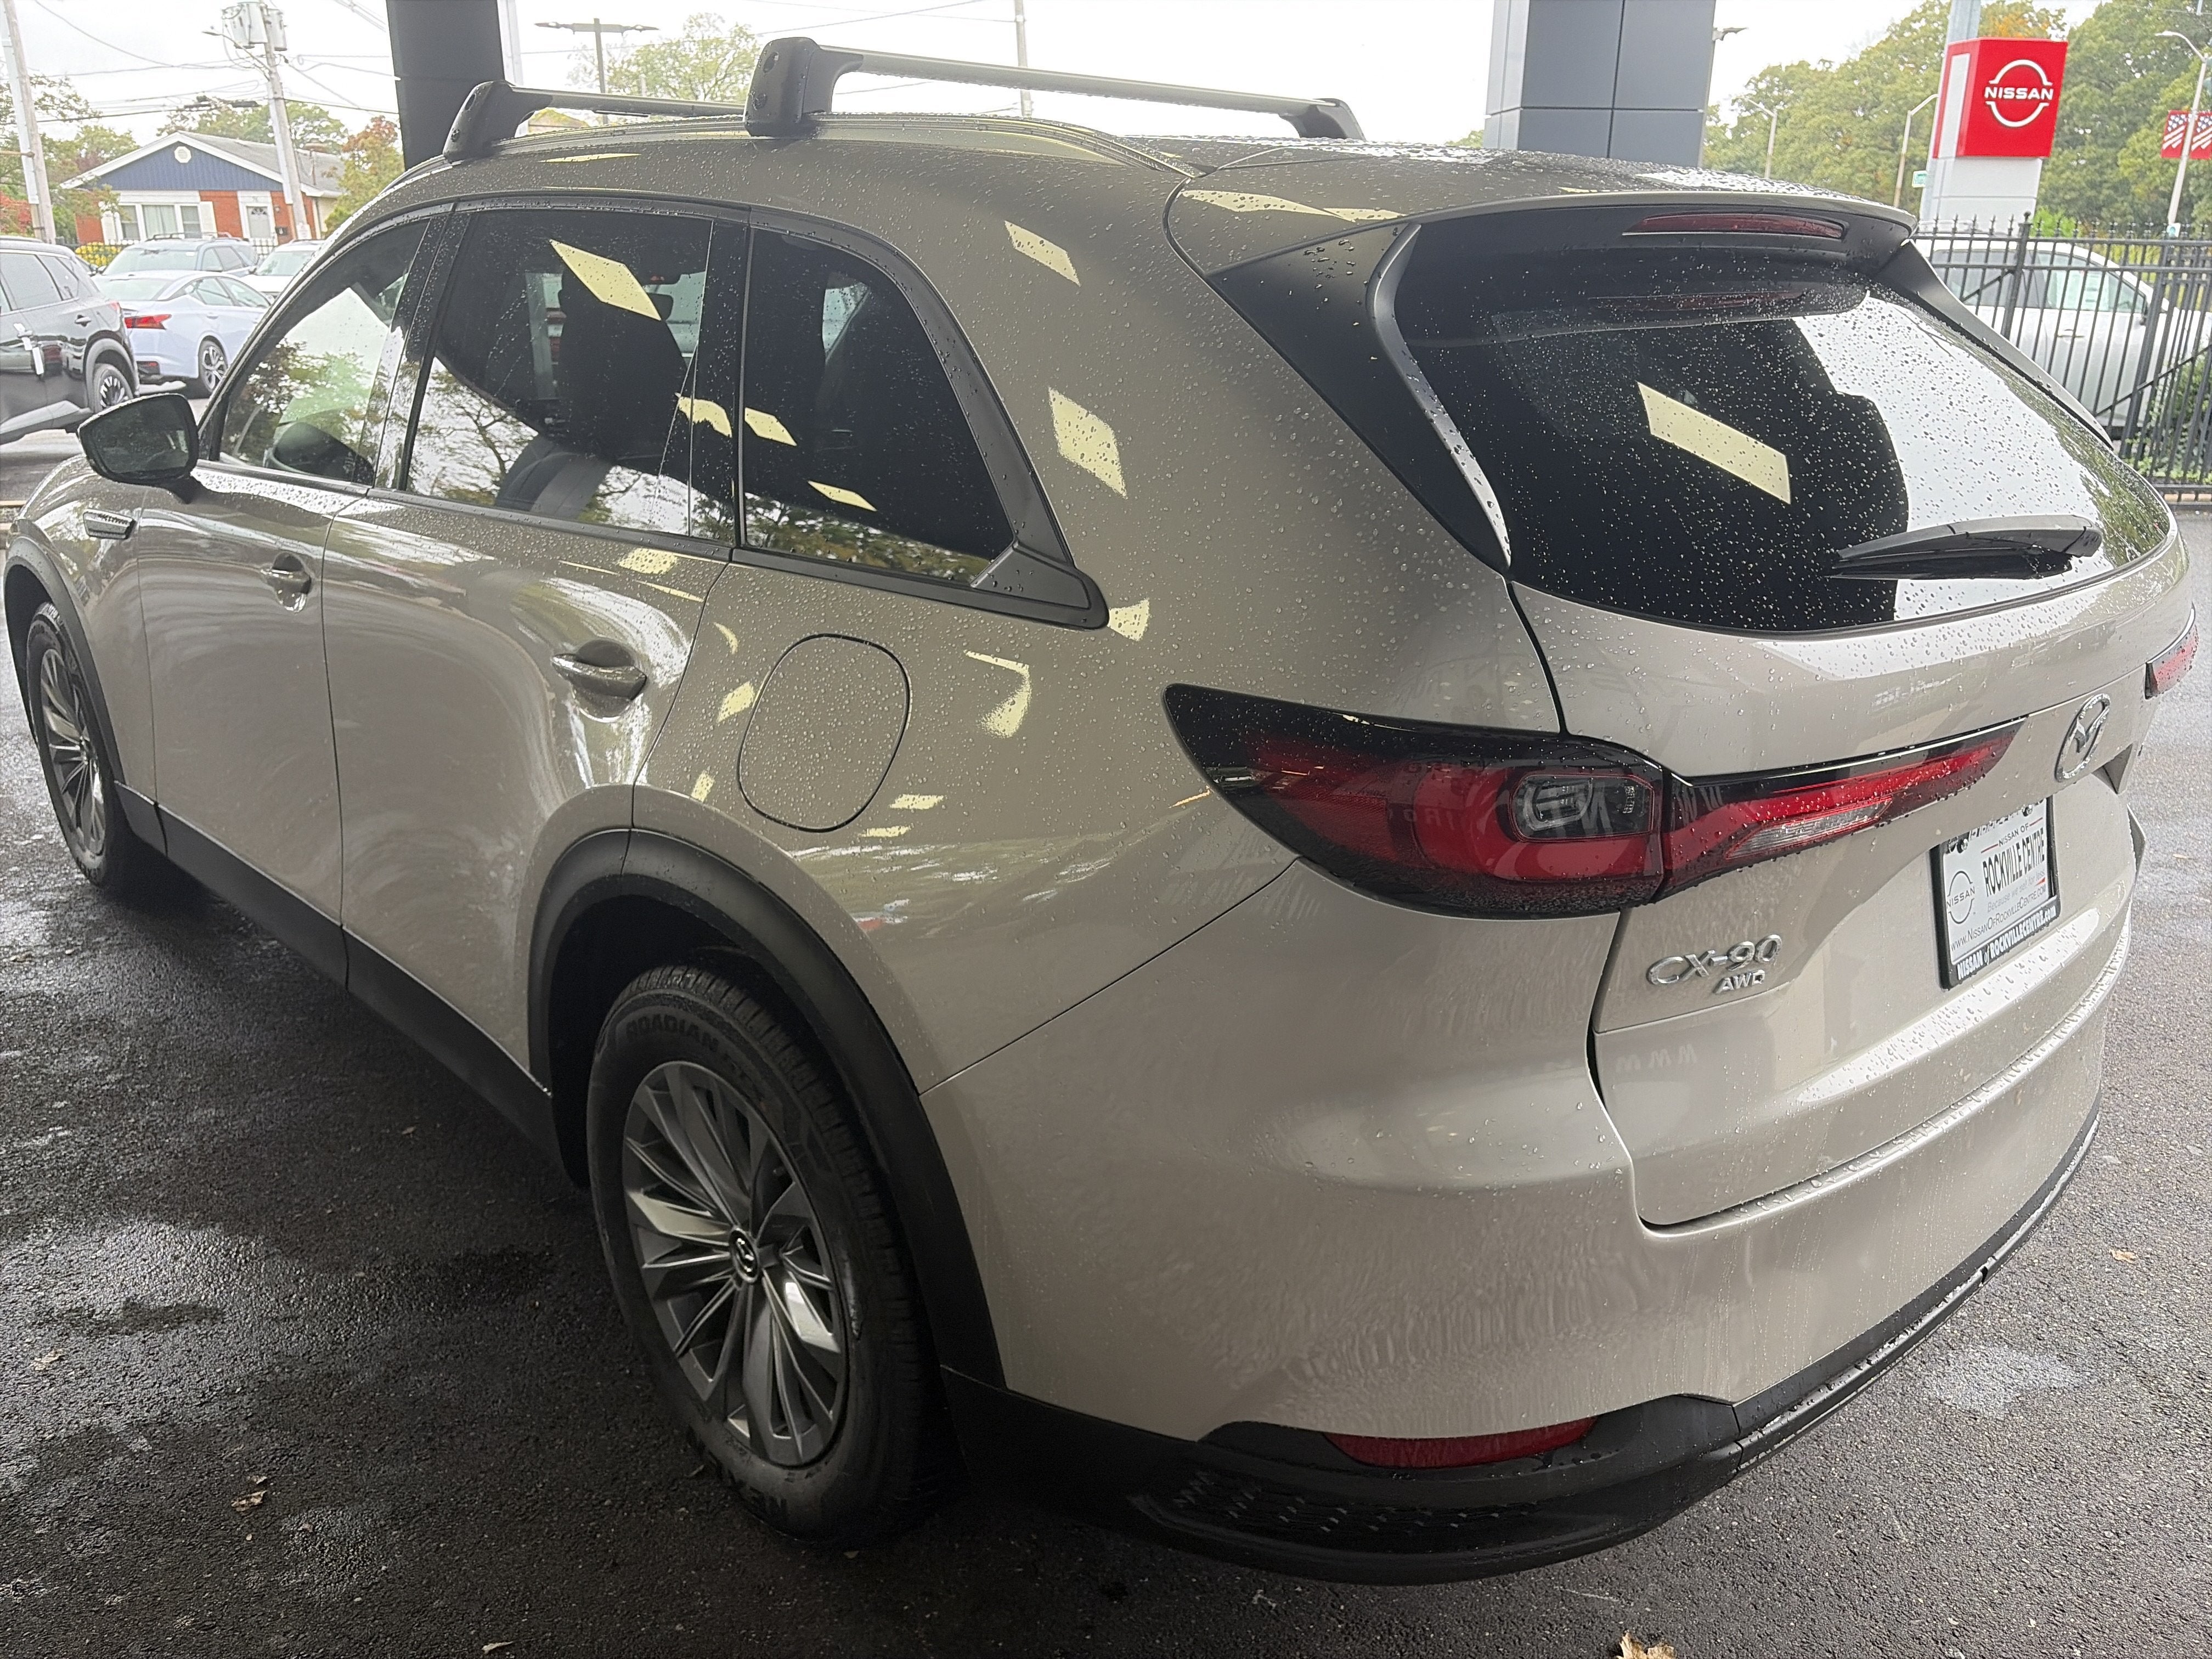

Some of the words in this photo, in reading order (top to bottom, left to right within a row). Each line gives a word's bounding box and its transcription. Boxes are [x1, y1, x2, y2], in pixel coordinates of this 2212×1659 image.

[1984, 86, 2053, 101] NISSAN
[1999, 828, 2018, 847] NISSAN
[2020, 822, 2029, 833] OF
[1982, 843, 2023, 897] ROCKVILLE
[2022, 827, 2045, 875] CENTRE
[1946, 886, 1975, 910] NISSAN
[1987, 893, 2011, 913] Because
[2011, 888, 2018, 898] we
[1646, 934, 1782, 985] CX-90
[1957, 950, 1984, 980] NISSAN
[1984, 944, 1990, 966] of
[1712, 969, 1765, 994] AWD
